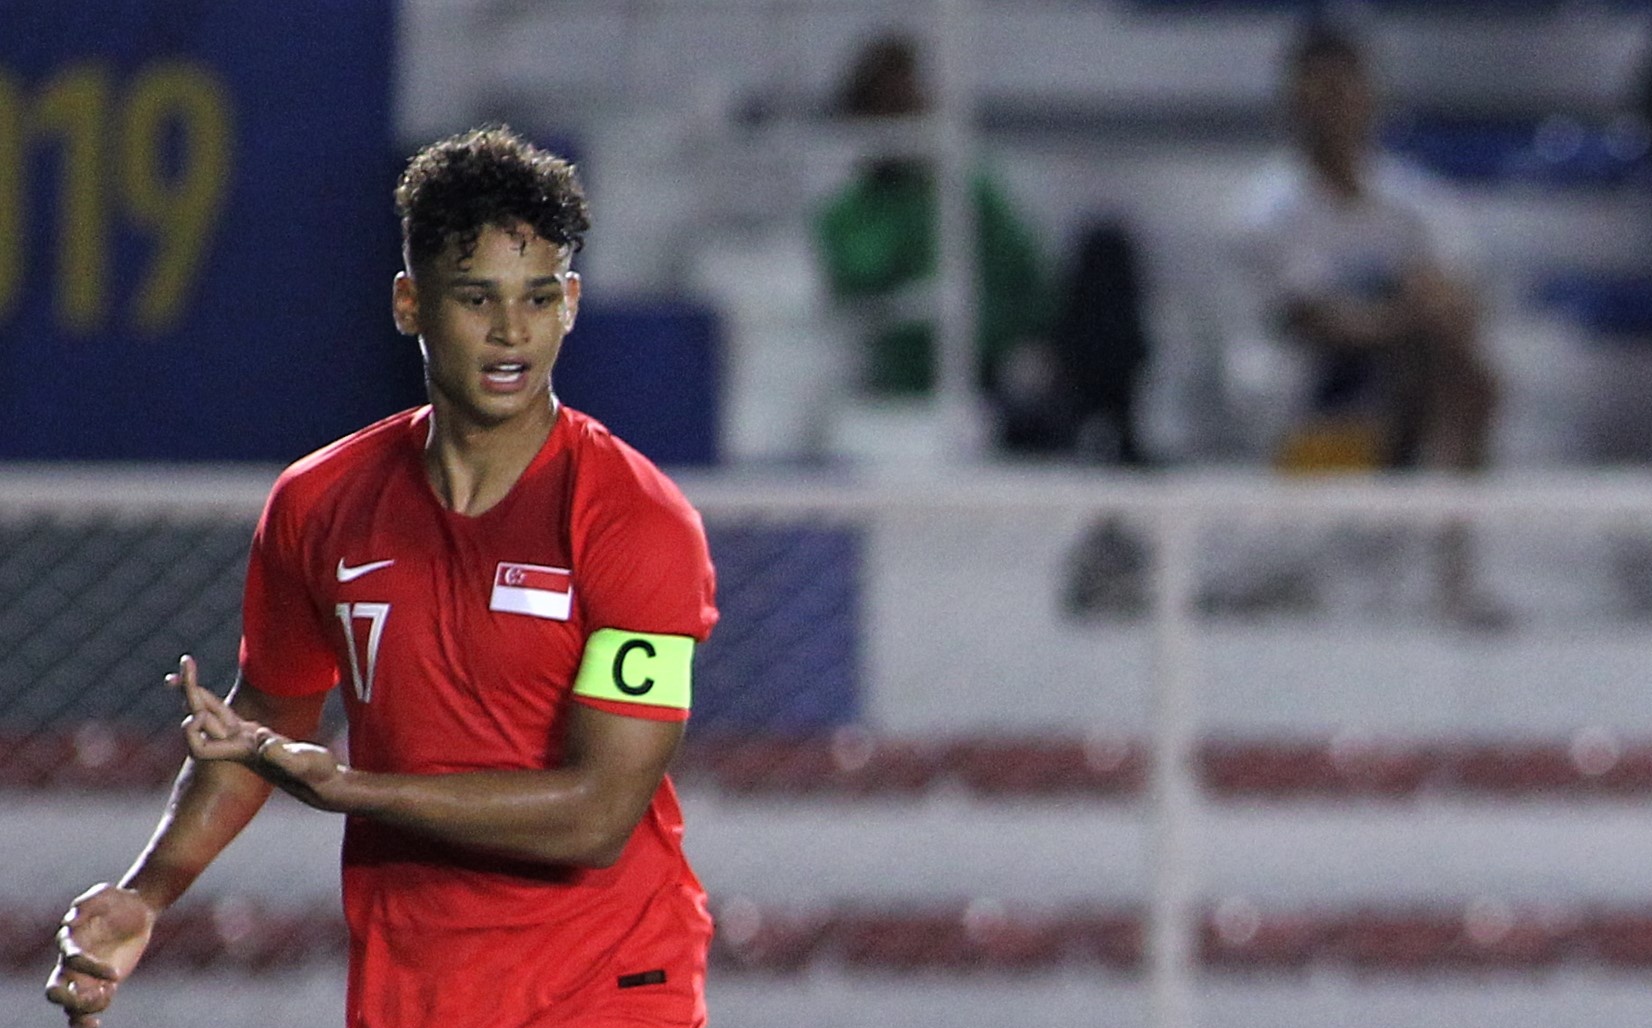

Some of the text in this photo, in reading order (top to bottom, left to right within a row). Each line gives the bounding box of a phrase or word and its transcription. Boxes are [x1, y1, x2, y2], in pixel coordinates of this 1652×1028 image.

[0, 60, 228, 334] 19
[335, 602, 391, 703] 17
[612, 638, 656, 696] C
